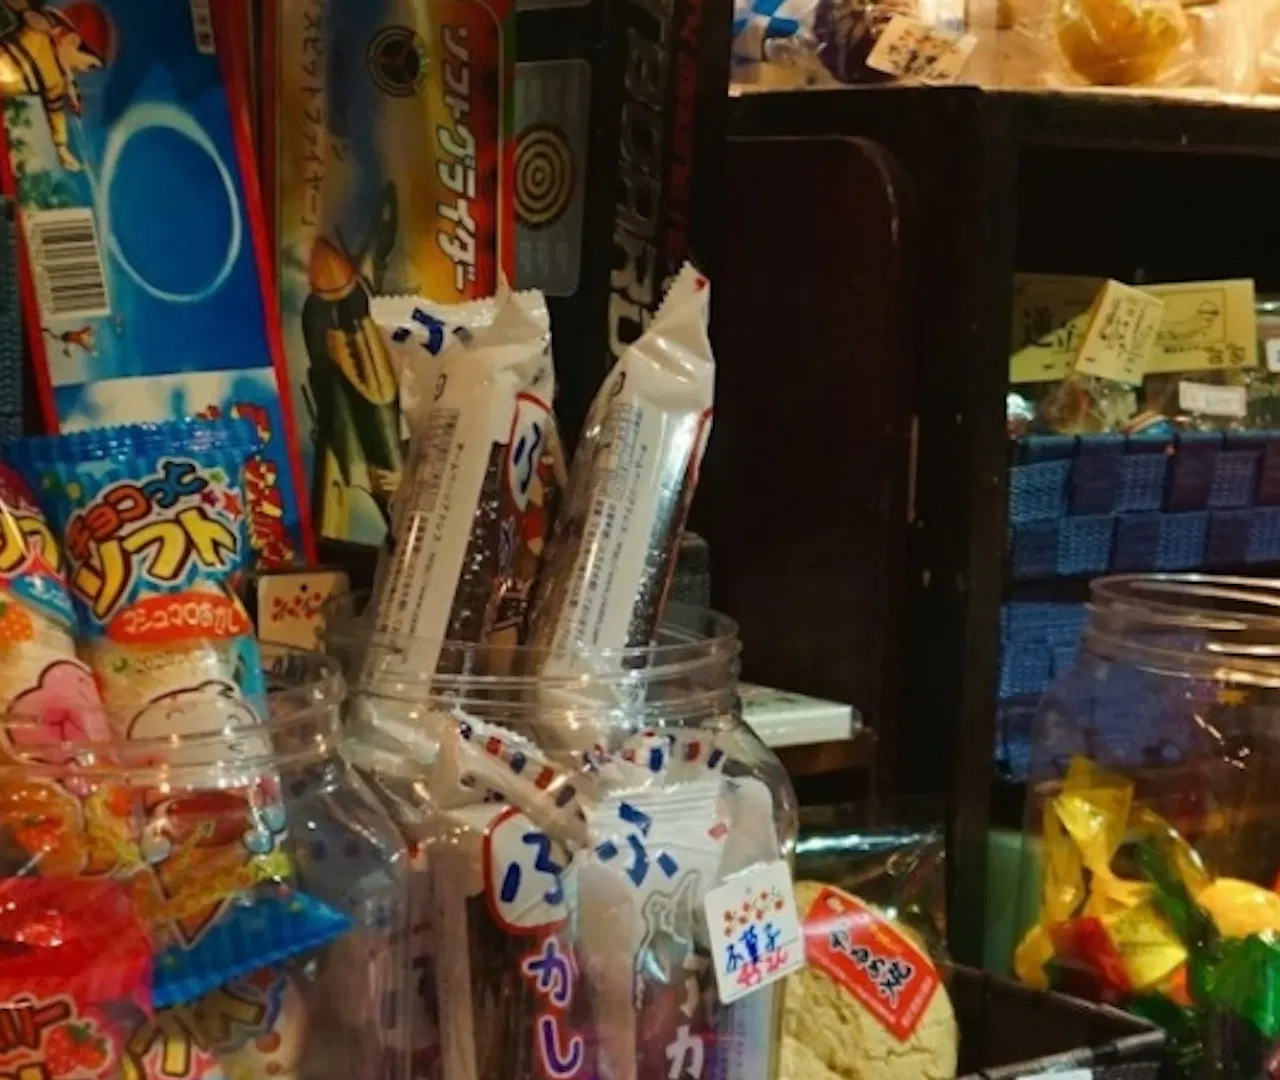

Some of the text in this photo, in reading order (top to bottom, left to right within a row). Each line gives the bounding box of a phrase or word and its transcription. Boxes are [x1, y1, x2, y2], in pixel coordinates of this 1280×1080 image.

[437, 23, 478, 294] ソフトグライダー
[69, 459, 211, 563] チョコっと
[72, 504, 240, 622] ソフト
